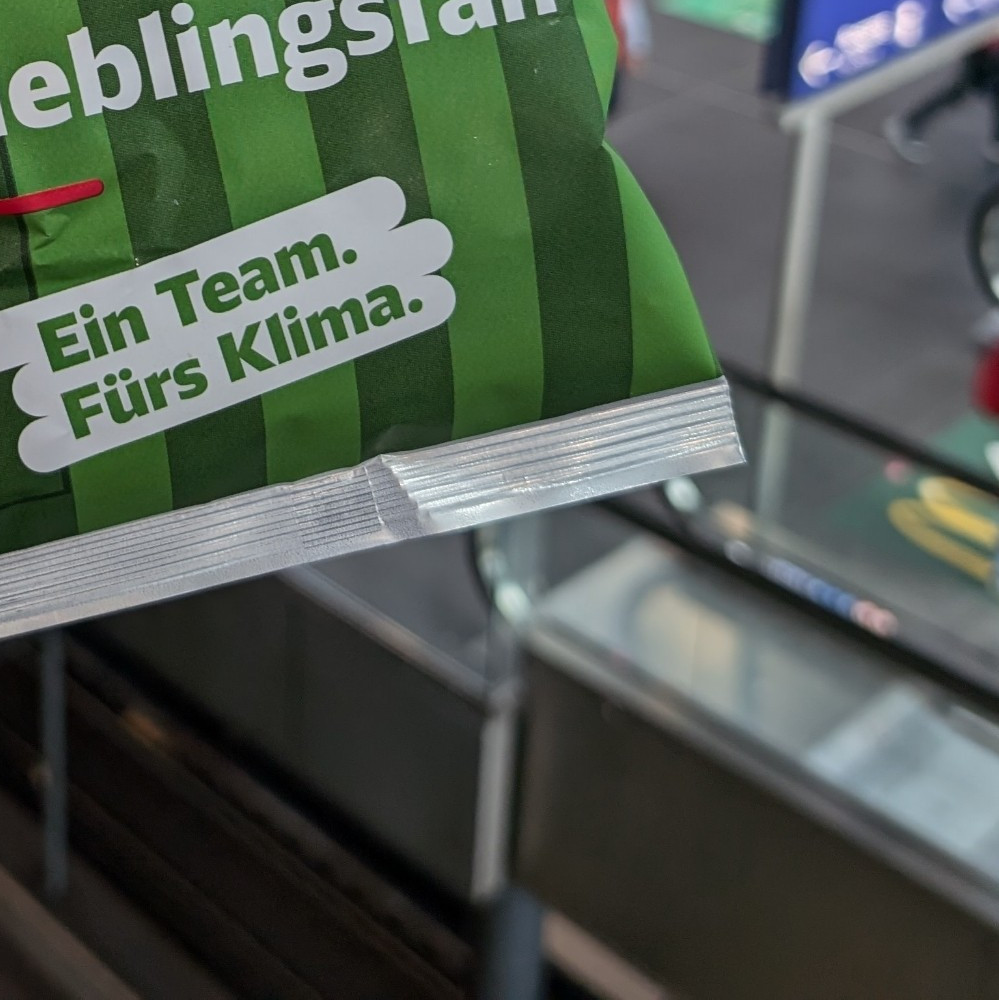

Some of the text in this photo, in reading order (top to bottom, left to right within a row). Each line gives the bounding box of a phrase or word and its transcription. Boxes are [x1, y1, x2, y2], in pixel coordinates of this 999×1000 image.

[37, 233, 357, 372] Ein Team.
[60, 282, 423, 440] Fürs Klima.
